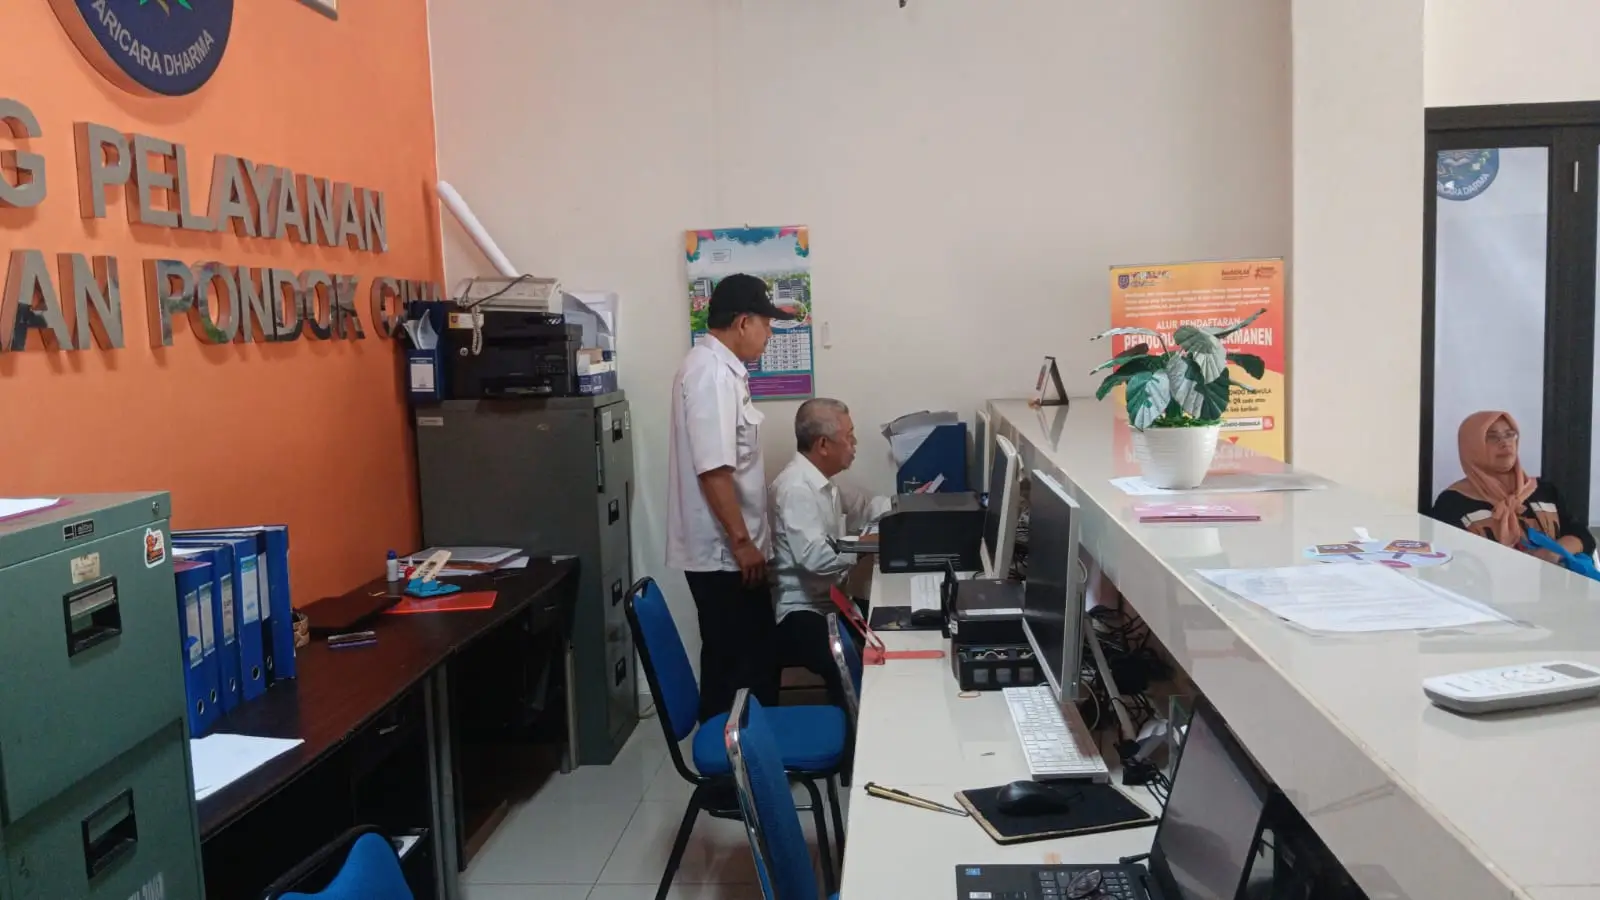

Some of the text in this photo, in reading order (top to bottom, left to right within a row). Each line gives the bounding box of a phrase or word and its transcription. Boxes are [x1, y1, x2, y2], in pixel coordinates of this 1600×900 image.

[91, 0, 215, 76] ARICARA DHARMA
[0, 97, 389, 253] G PELAYANAN
[1, 249, 126, 352] AN
[142, 259, 366, 349] PONDOK
[1156, 320, 1178, 330] ALUR
